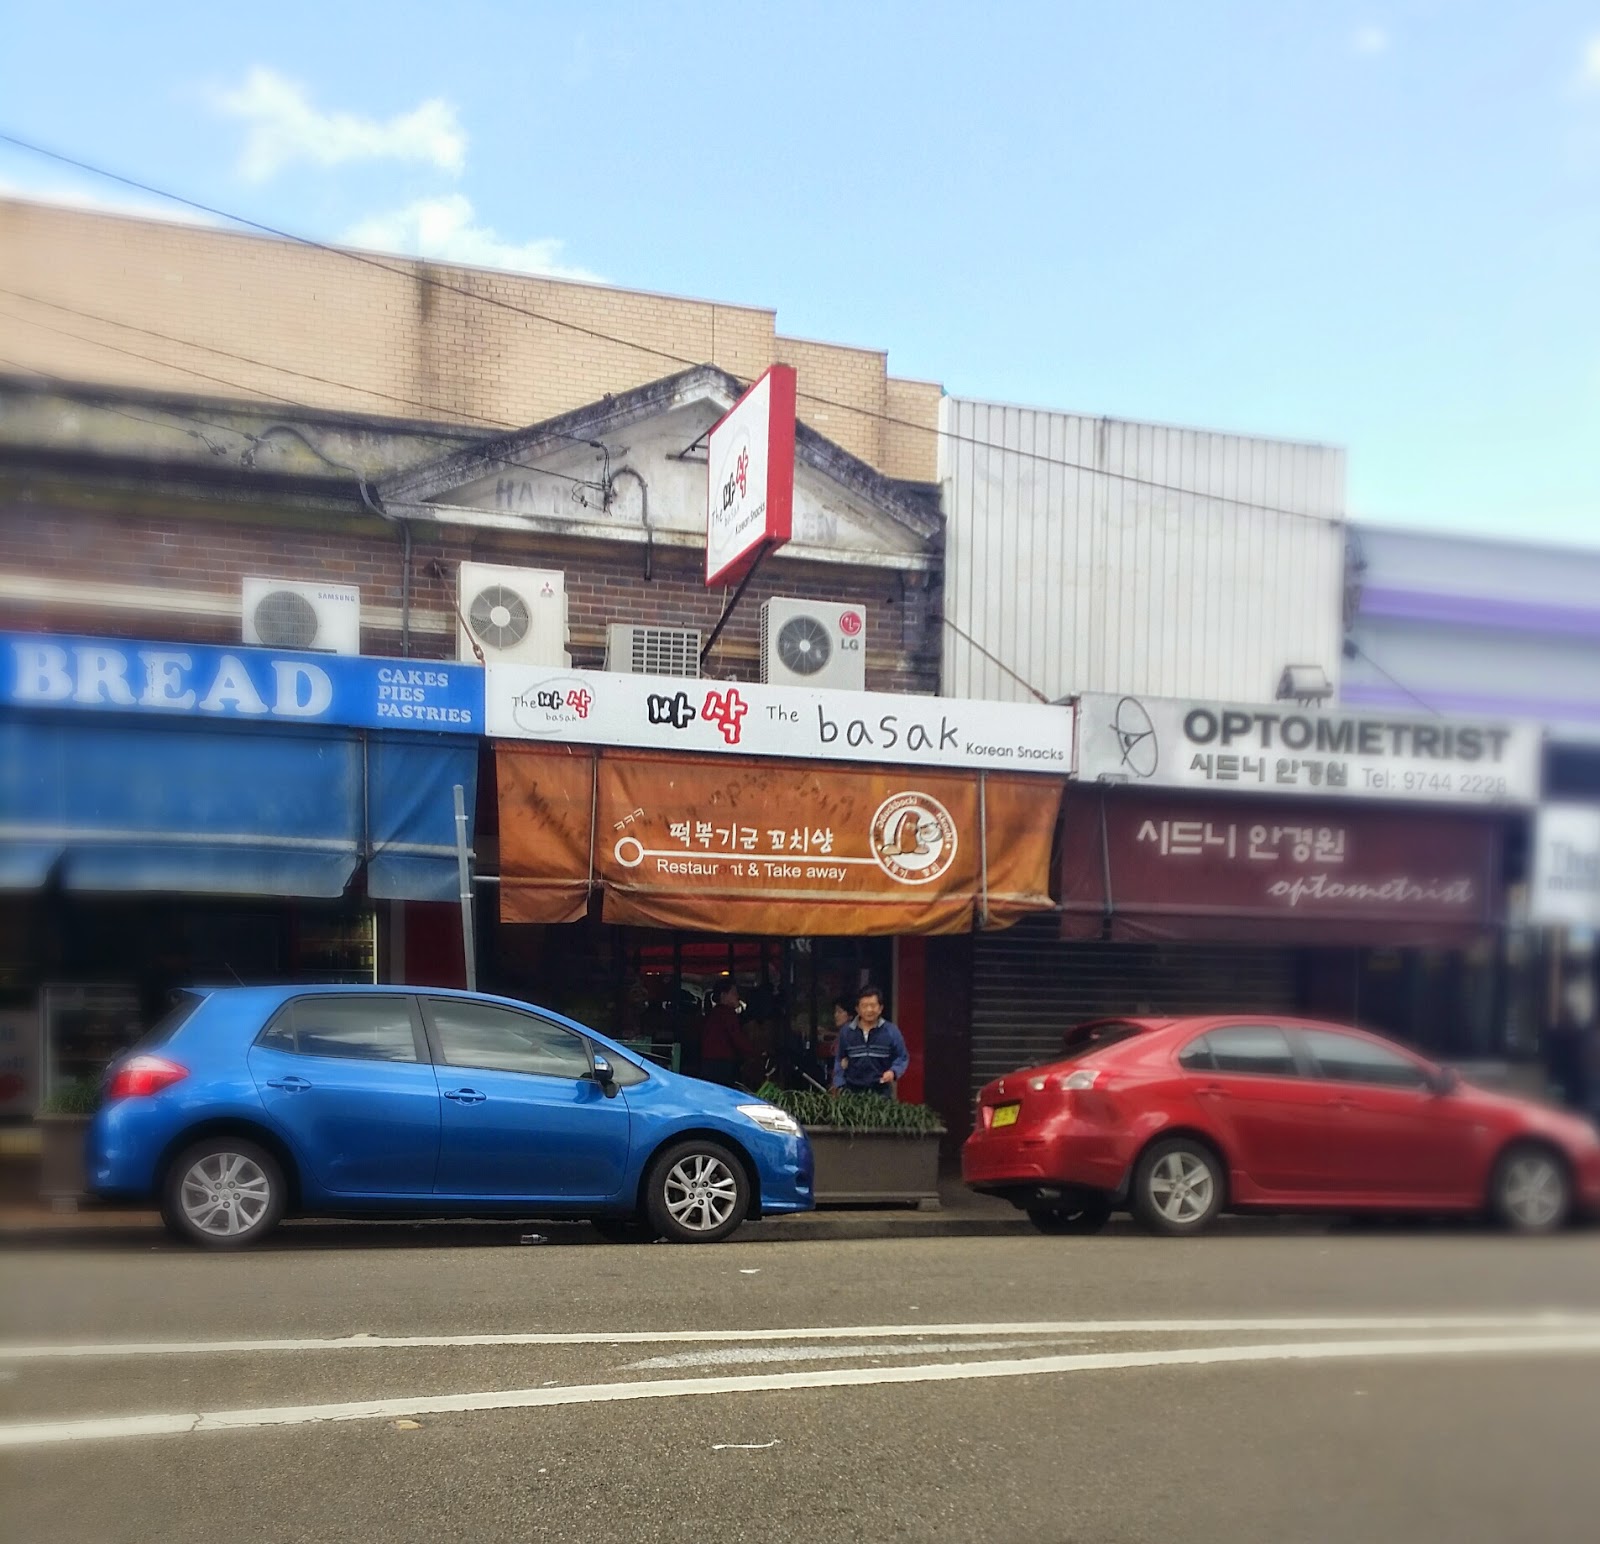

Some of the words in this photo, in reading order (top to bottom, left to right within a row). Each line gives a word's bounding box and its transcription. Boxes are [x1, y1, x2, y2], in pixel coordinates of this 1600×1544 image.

[317, 592, 355, 602] SAMSUNG
[841, 638, 859, 651] LG
[12, 642, 333, 717] BREAD
[378, 667, 449, 688] CAKES
[378, 685, 426, 702] PIES
[511, 695, 537, 709] The
[377, 702, 473, 723] PASTRIES
[545, 712, 577, 723] basak
[766, 705, 800, 722] The
[817, 704, 959, 750] basak
[966, 742, 1013, 758] Korean
[1017, 745, 1064, 761] Snacks
[1183, 707, 1511, 764] OPTOMETRIST
[1189, 752, 1266, 783] 시드니
[1275, 756, 1348, 788] 안경원
[1361, 767, 1397, 789] Tel:
[1403, 770, 1452, 792] 9744
[1136, 819, 1236, 858] 시드니
[1248, 824, 1345, 863] 안경원
[747, 862, 759, 877] &
[763, 863, 801, 878] Take
[806, 866, 847, 882] away
[1267, 872, 1474, 906] optometrist
